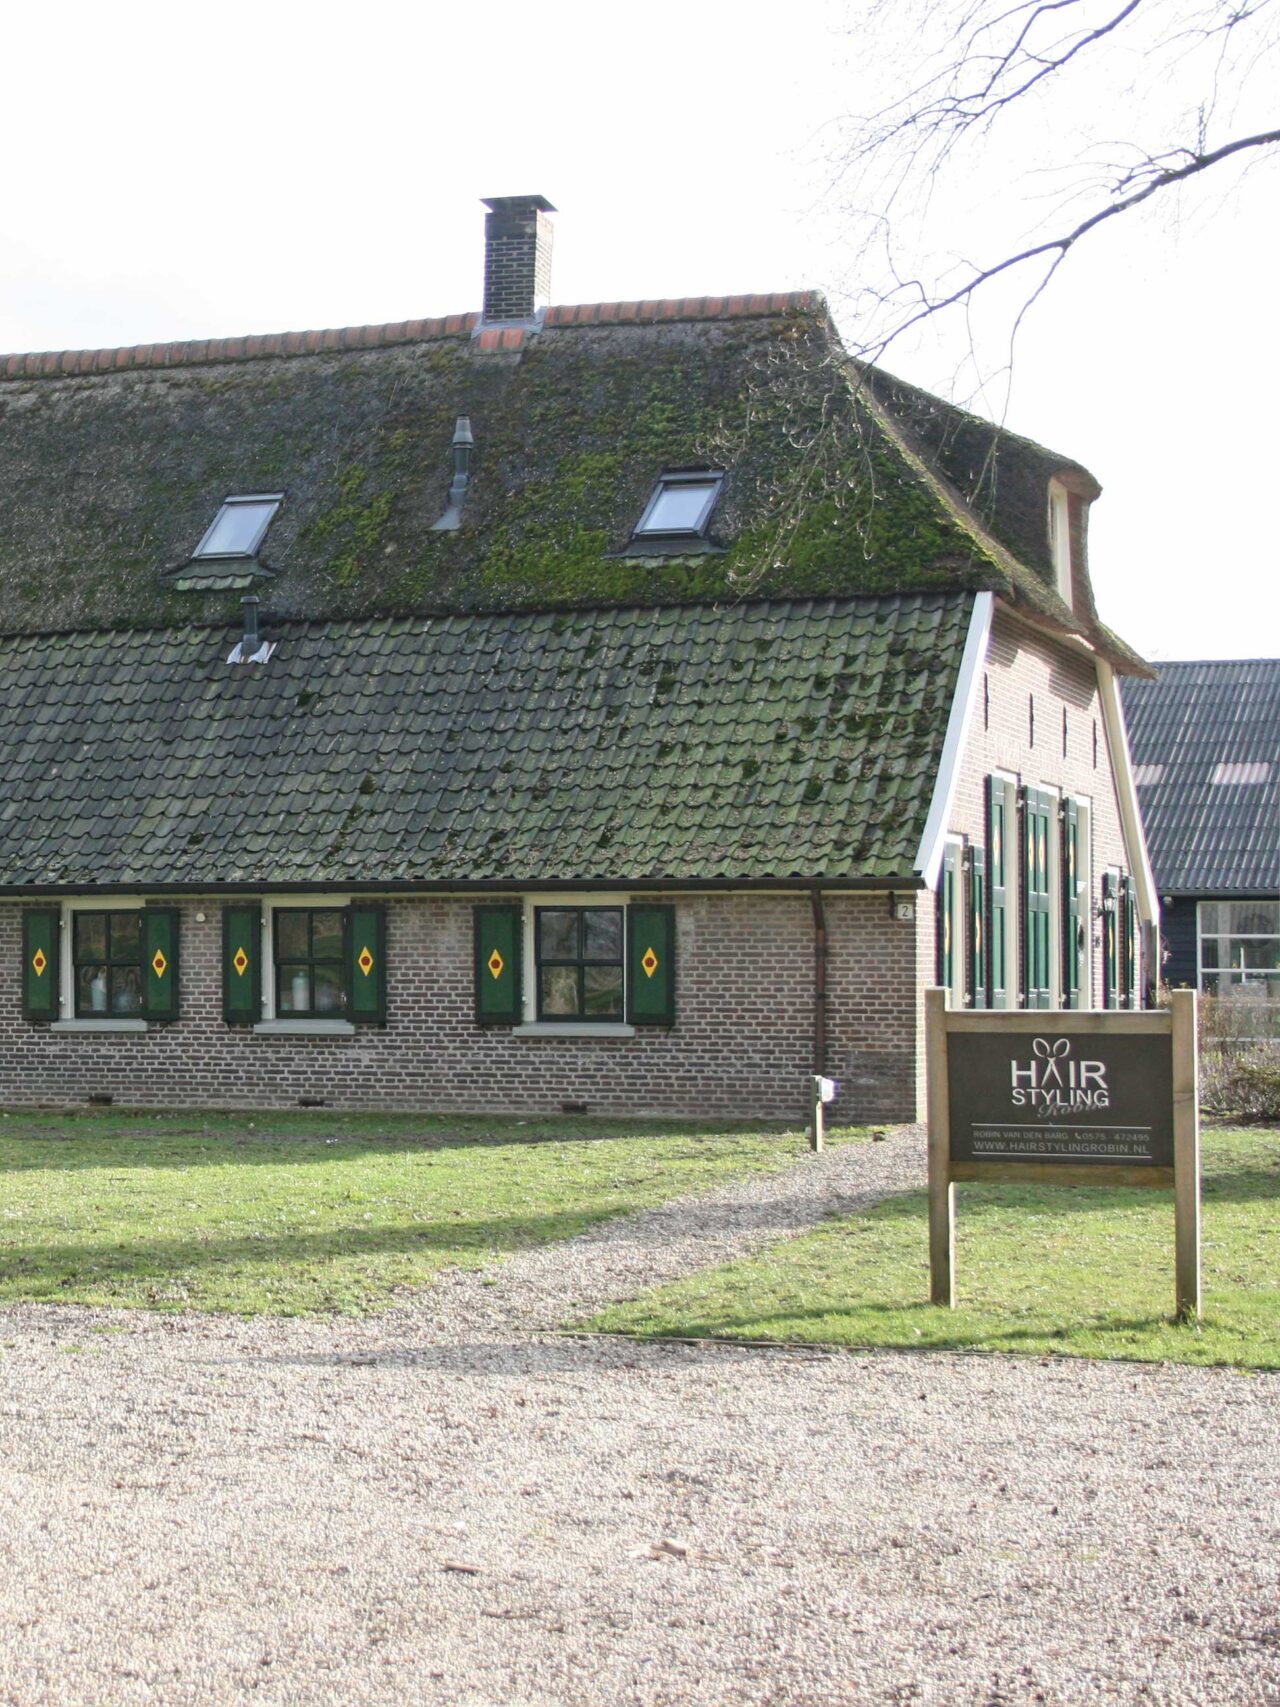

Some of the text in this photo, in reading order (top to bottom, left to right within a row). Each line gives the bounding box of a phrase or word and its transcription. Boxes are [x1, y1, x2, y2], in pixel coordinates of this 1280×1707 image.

[902, 905, 909, 918] 2
[1011, 1058, 1108, 1089] HAIR
[1011, 1088, 1109, 1106] STYLING
[972, 1130, 1001, 1138] ROBIN
[1002, 1131, 1021, 1139] VAN
[1022, 1131, 1042, 1139] DEN
[1081, 1132, 1106, 1140] 0575
[973, 1141, 1150, 1154] WWW.HAIRSTYLINGROBIN.NL
